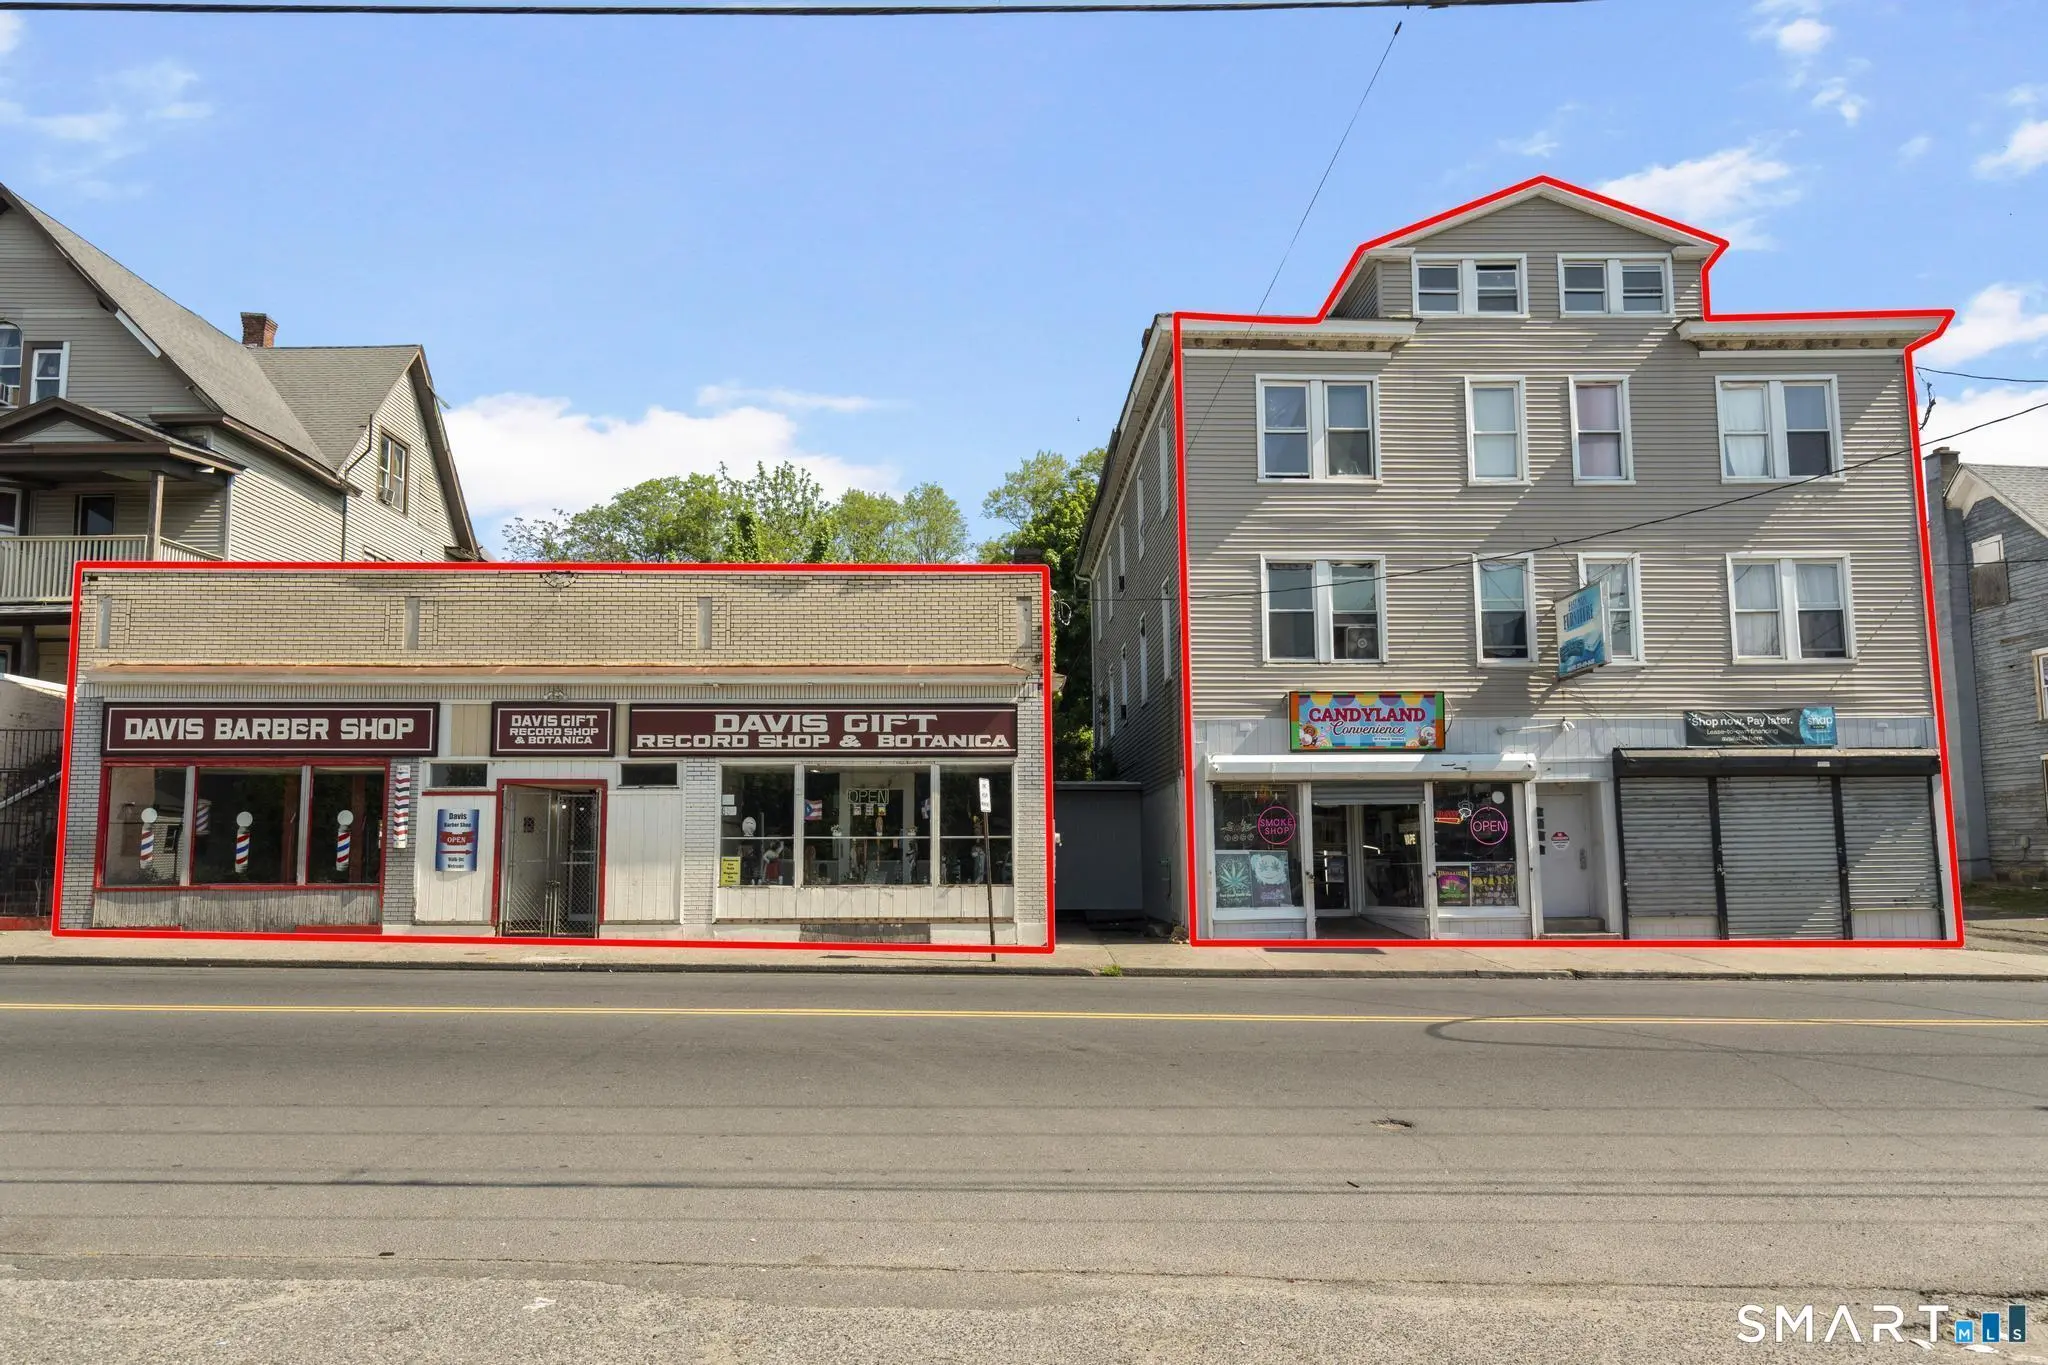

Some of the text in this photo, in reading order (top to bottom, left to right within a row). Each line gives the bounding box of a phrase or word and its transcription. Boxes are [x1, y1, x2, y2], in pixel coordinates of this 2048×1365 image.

[1308, 707, 1426, 722] CANDYLAND
[511, 715, 598, 727] DAVIS GIFT
[714, 714, 938, 733] DAVIS GIFT
[1691, 717, 1719, 728] Shop
[1746, 716, 1766, 727] Pay
[1767, 716, 1794, 725] later.
[1807, 716, 1833, 727] snap
[124, 718, 415, 740] DAVIS BARBER SHOP
[509, 728, 599, 736] RECORD SHOP
[1330, 721, 1405, 735] Convenience
[1750, 728, 1779, 736] financing
[514, 736, 593, 744] & BOTANICA
[636, 734, 1010, 748] RECORD SHOP & BOTANICA
[848, 789, 888, 803] OPEN
[448, 812, 468, 820] Davis
[1260, 818, 1293, 827] SMOKE
[1472, 820, 1507, 832] OPEN
[1264, 826, 1290, 835] SHOP
[447, 836, 466, 844] OPEN
